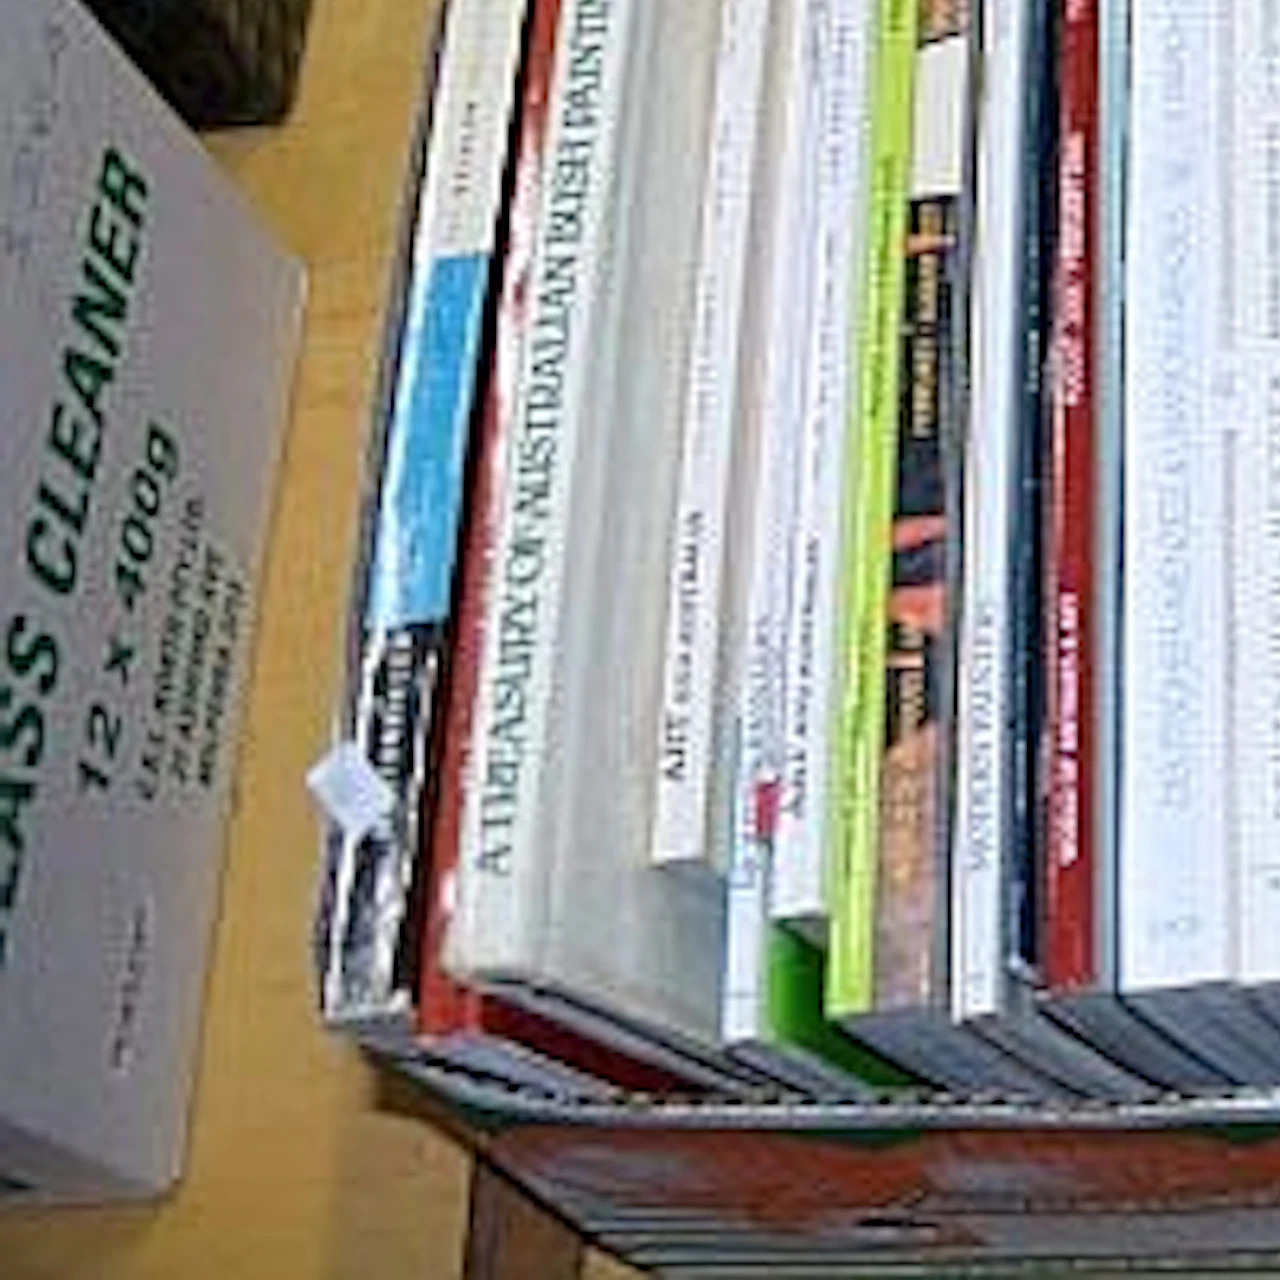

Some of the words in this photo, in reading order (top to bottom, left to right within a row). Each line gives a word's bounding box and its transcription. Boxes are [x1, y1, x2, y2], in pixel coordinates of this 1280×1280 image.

[545, 138, 596, 244] BUSH
[28, 146, 148, 596] CLEANER
[514, 257, 576, 518] AUSTRALIAN
[78, 704, 121, 793] 12
[114, 418, 180, 612] 400g
[483, 578, 541, 826] TREASURY
[478, 832, 511, 878] A
